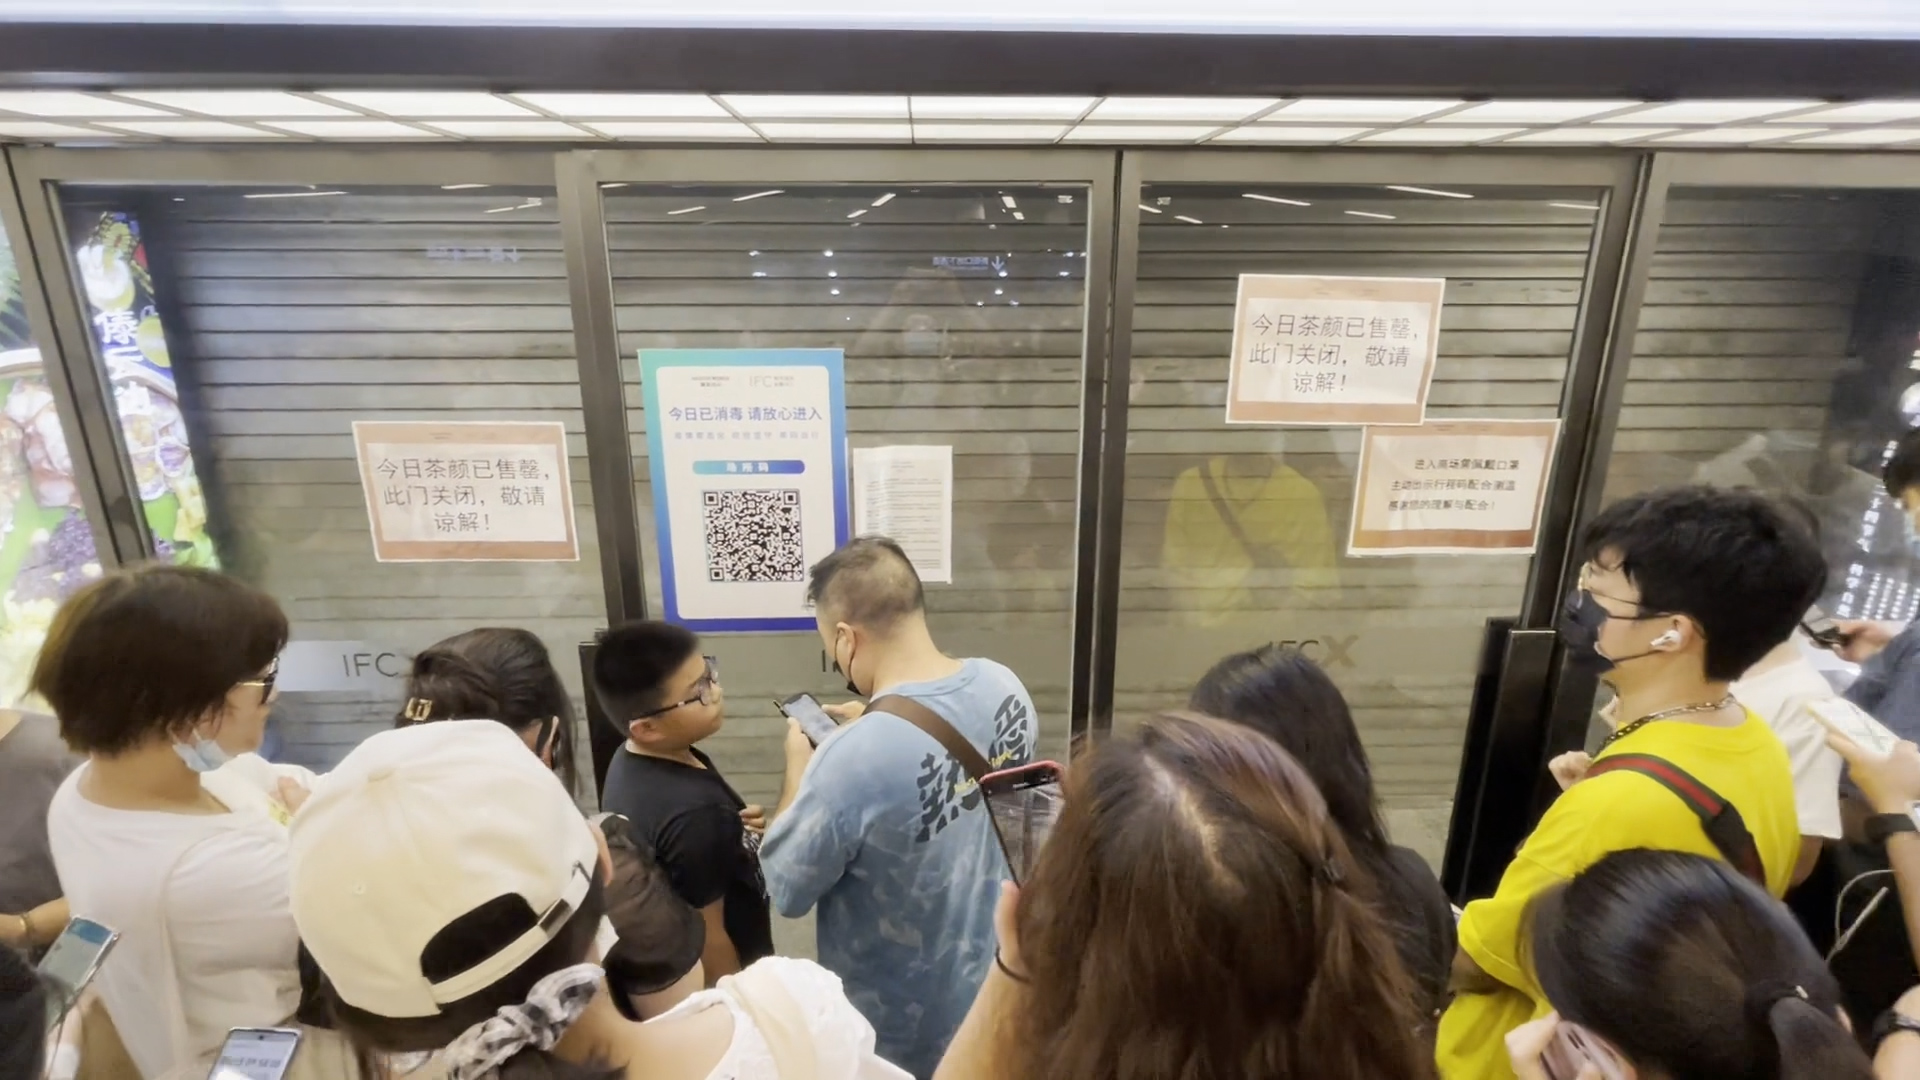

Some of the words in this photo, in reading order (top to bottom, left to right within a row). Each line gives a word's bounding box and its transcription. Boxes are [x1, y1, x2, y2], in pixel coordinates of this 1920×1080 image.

[1252, 313, 1418, 342] 今日茶颜已售罄，
[1248, 343, 1411, 368] 此门关闭，敬请
[1293, 371, 1347, 394] 谅解！
[669, 406, 744, 422] 今日已消毒
[747, 406, 823, 422] 请放心进入
[376, 458, 551, 481] 今日茶颜已售罄，
[384, 485, 546, 507] 此门关闭，敬请
[434, 512, 491, 533] 谅解！
